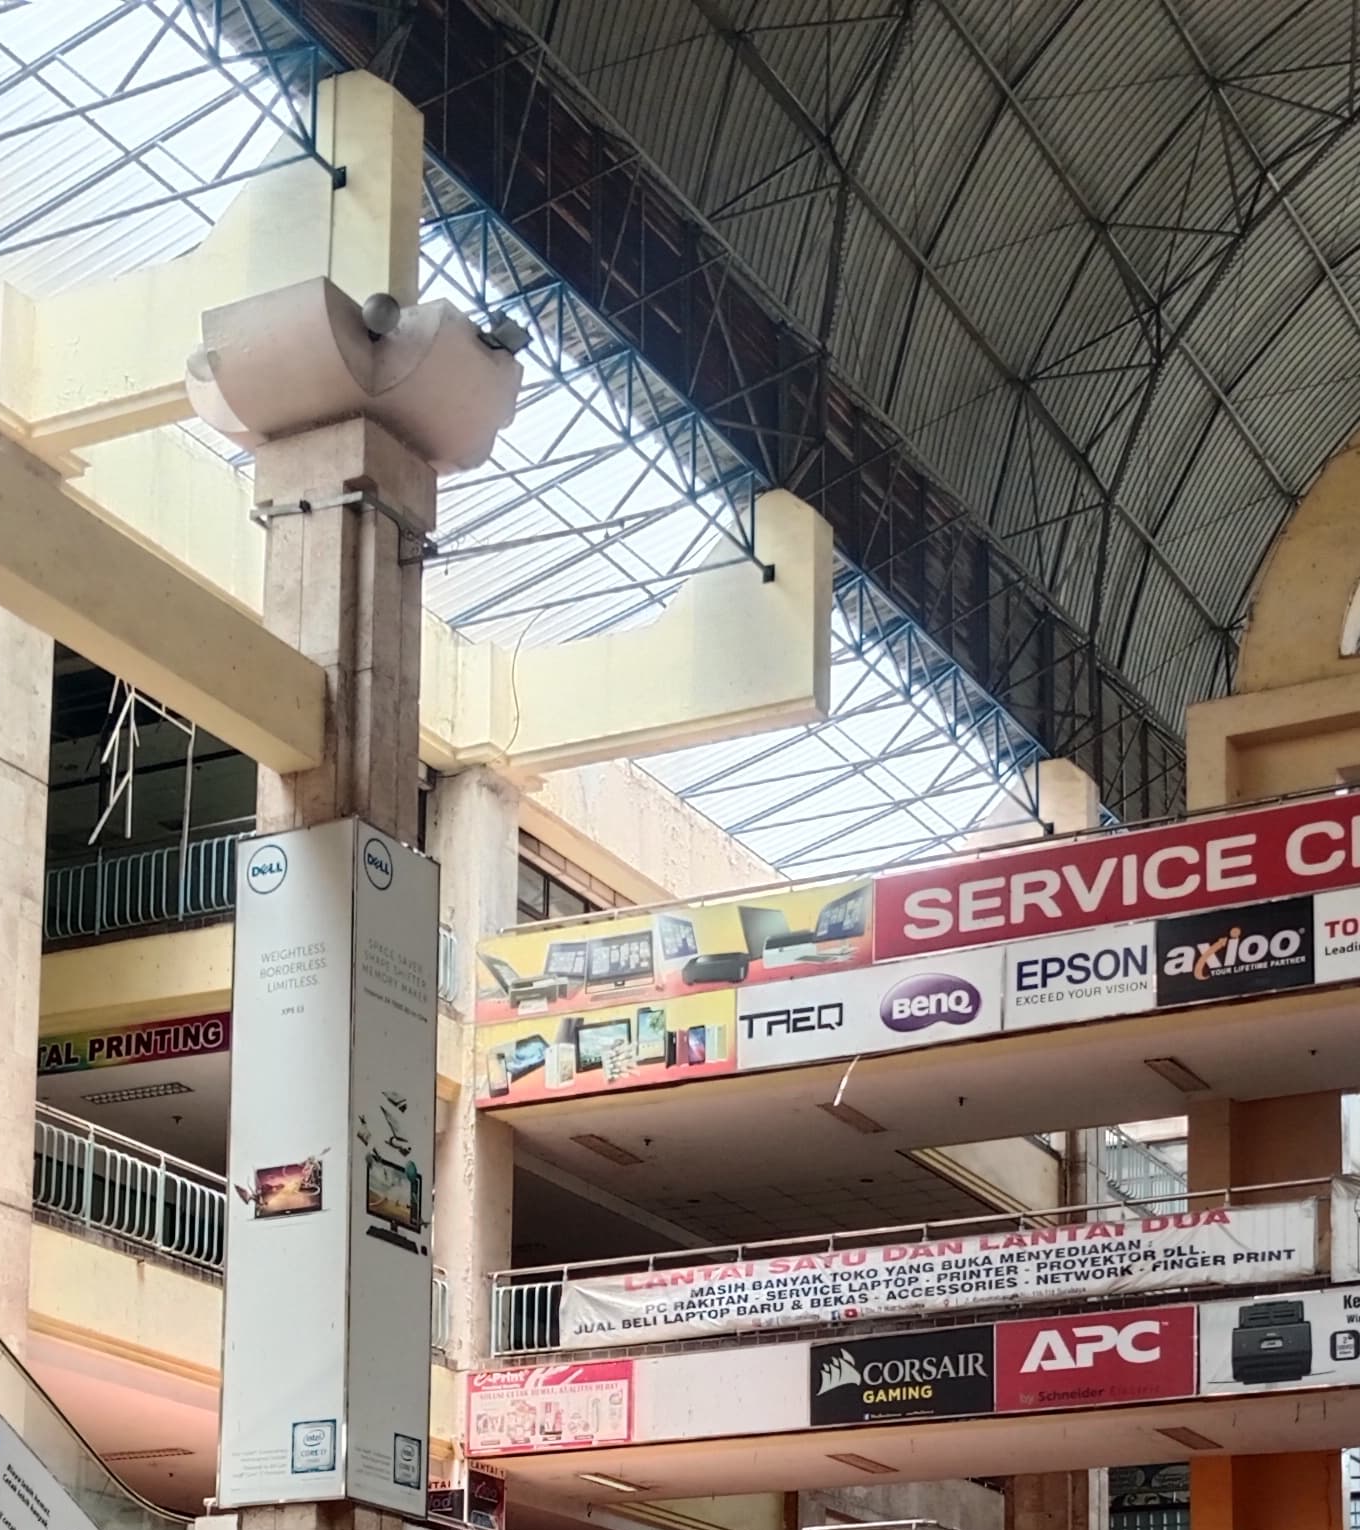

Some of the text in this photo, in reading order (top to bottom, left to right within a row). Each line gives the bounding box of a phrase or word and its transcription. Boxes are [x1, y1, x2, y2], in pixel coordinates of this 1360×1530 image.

[903, 834, 1256, 940] SERVICE
[1016, 945, 1148, 992] EPSON
[1164, 927, 1300, 980] axioo
[1233, 955, 1306, 974] LIFETIME PARTNER
[1016, 980, 1148, 1006] EXCEED YOUR VISION
[89, 1020, 223, 1063] PRINTING
[624, 1208, 1231, 1291] LANTAI SATU DAN LANTAI DUA
[690, 1239, 1142, 1298] MASIH BANYAK TOKO YANG BUKA MENYEDIAKAN
[574, 1249, 1295, 1335] JUAL BELI LAPTOP BARU BEKAS ACCESSORIES NETWORK FINGER PRINT
[673, 1294, 749, 1311] RAKITAN
[766, 1282, 842, 1301] SERVICE
[848, 1276, 919, 1293] LAPTOP
[937, 1266, 1018, 1283] PRINTER
[1036, 1250, 1156, 1272] PROYEKTOR
[862, 1352, 989, 1385] CORSAIR
[1019, 1320, 1161, 1374] APC
[862, 1385, 933, 1404] GAMING
[1039, 1385, 1105, 1402] Schneider
